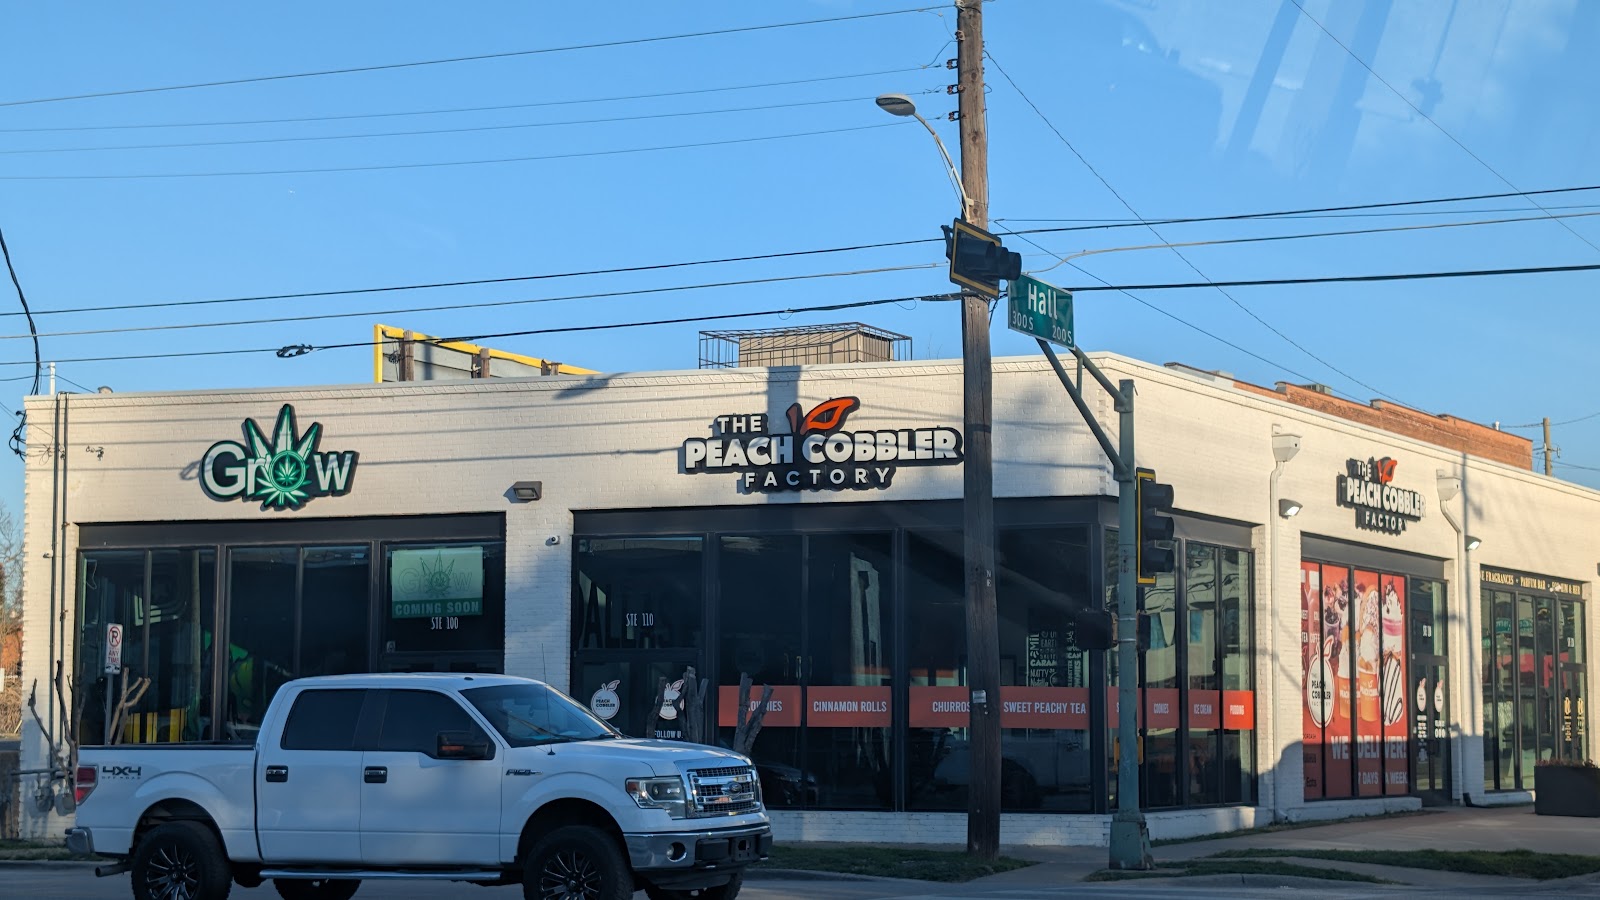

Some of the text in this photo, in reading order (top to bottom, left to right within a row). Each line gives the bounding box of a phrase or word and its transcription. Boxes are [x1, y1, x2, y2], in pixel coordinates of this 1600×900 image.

[1028, 283, 1057, 320] Hall
[1012, 310, 1033, 330] 300 S
[1052, 325, 1072, 344] 200 S
[717, 415, 762, 434] THE
[685, 429, 958, 469] PEACH COBBLER
[204, 443, 353, 497] Grow
[745, 467, 890, 488] FACTORY
[1357, 461, 1371, 478] THE
[1347, 477, 1426, 518] PEACH COBBLER
[1366, 511, 1408, 531] FACTORY
[395, 601, 479, 616] COMING SOON
[431, 617, 459, 630] STE 100
[626, 613, 654, 627] STE 110
[109, 649, 119, 657] ANY
[813, 701, 887, 713] CINNAMON ROLLS
[932, 701, 970, 712] CHURROS
[1004, 702, 1086, 714] SWEET PEACHY TEA
[1153, 703, 1169, 714] COOKIES
[1331, 736, 1349, 759] WE
[1363, 772, 1378, 785] DAYS
[1390, 772, 1408, 784] WEEK
